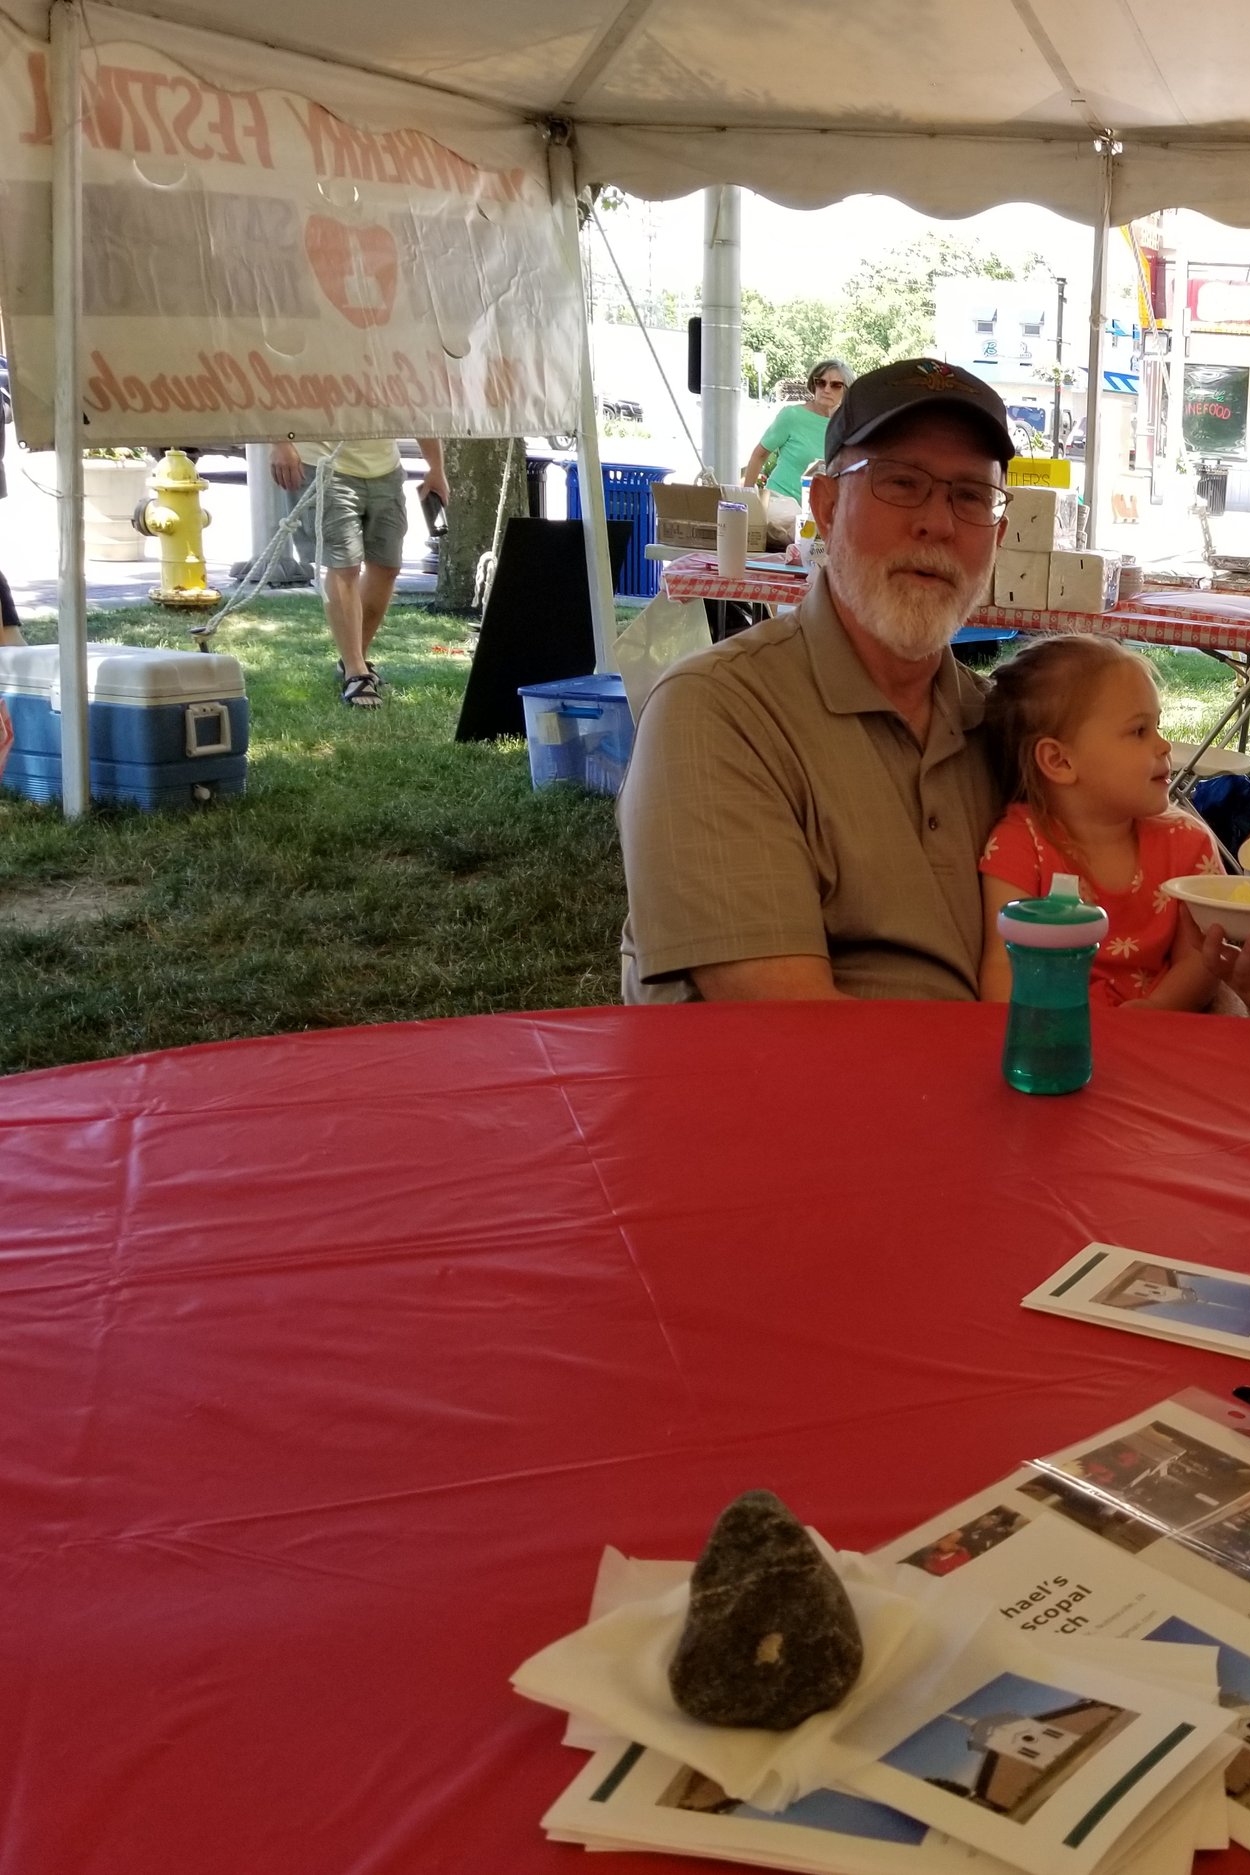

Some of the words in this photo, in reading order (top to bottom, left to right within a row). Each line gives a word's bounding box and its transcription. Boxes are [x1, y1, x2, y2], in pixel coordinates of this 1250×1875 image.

[1203, 403, 1232, 420] FOOD
[1008, 471, 1050, 487] TLER'S
[1000, 1576, 1068, 1619] hael's
[1020, 1584, 1092, 1631] scopal
